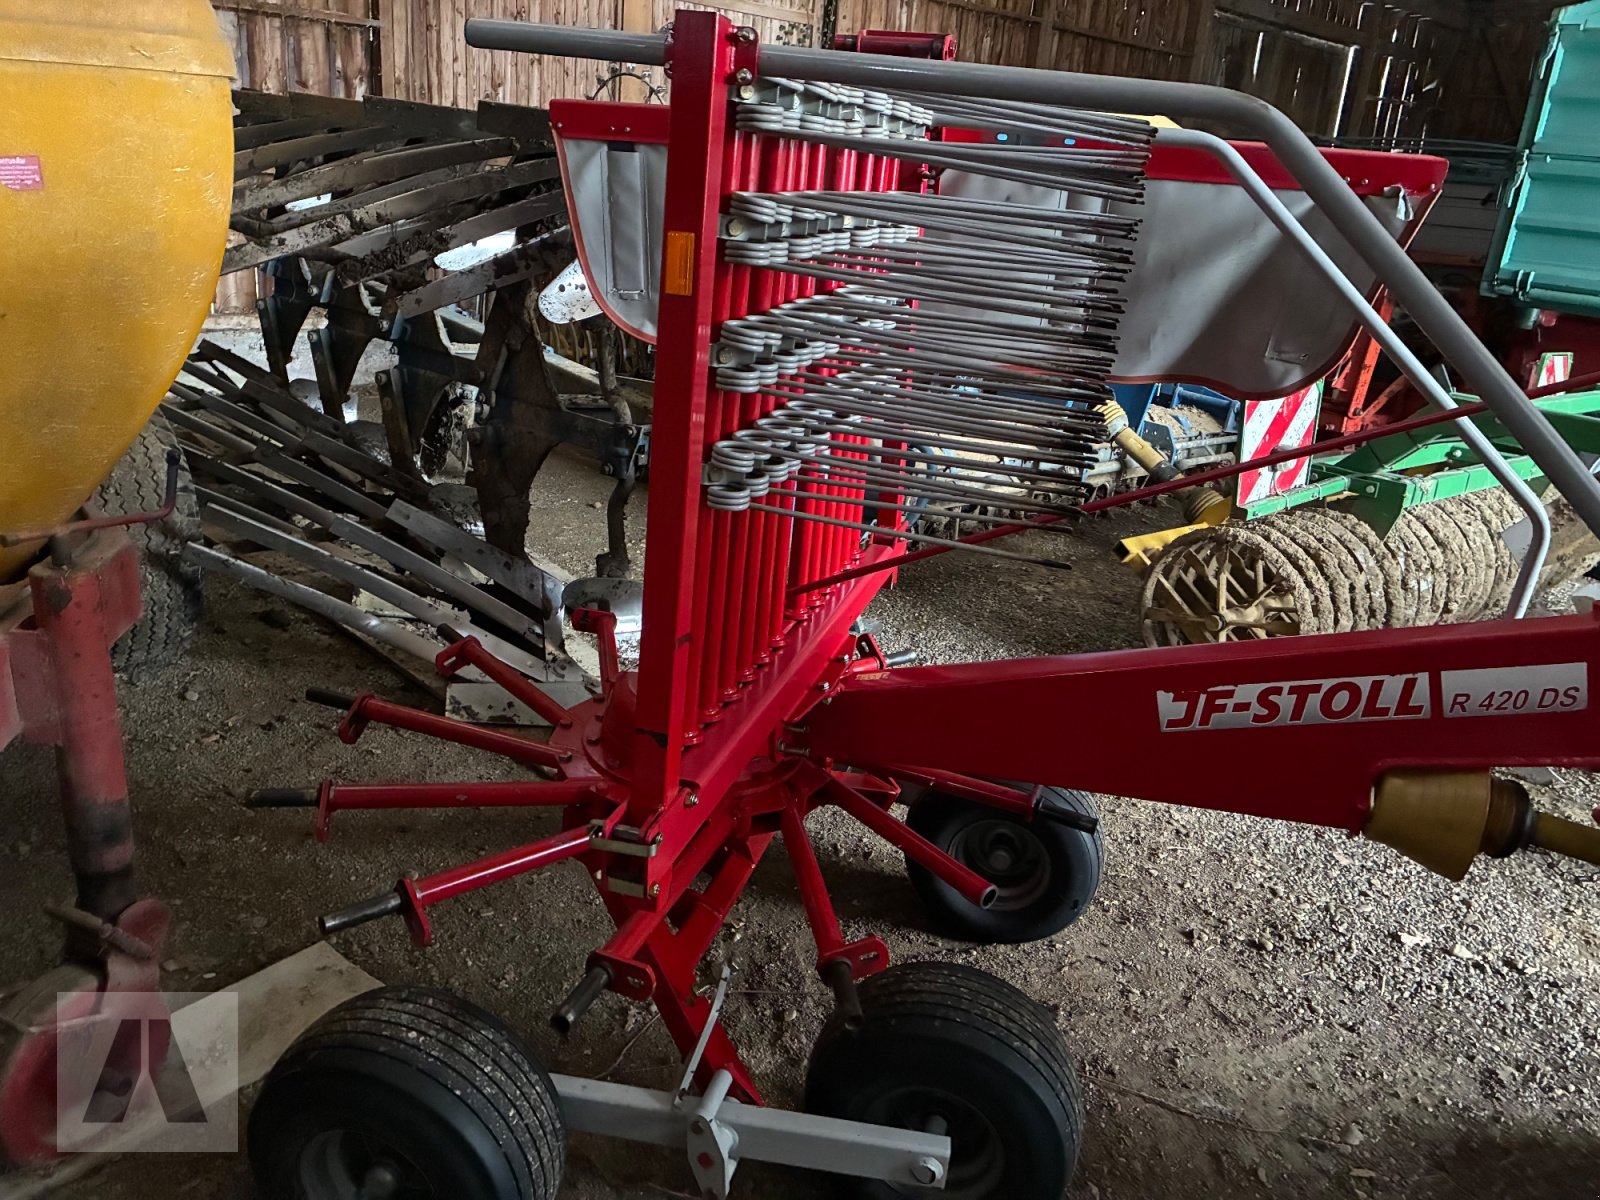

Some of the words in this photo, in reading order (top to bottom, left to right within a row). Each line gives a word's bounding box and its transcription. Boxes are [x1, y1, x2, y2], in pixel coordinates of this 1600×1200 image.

[1162, 676, 1426, 729] JF-STOLL
[1448, 692, 1472, 714] R
[1478, 689, 1530, 712] 420
[1537, 685, 1581, 710] DS
